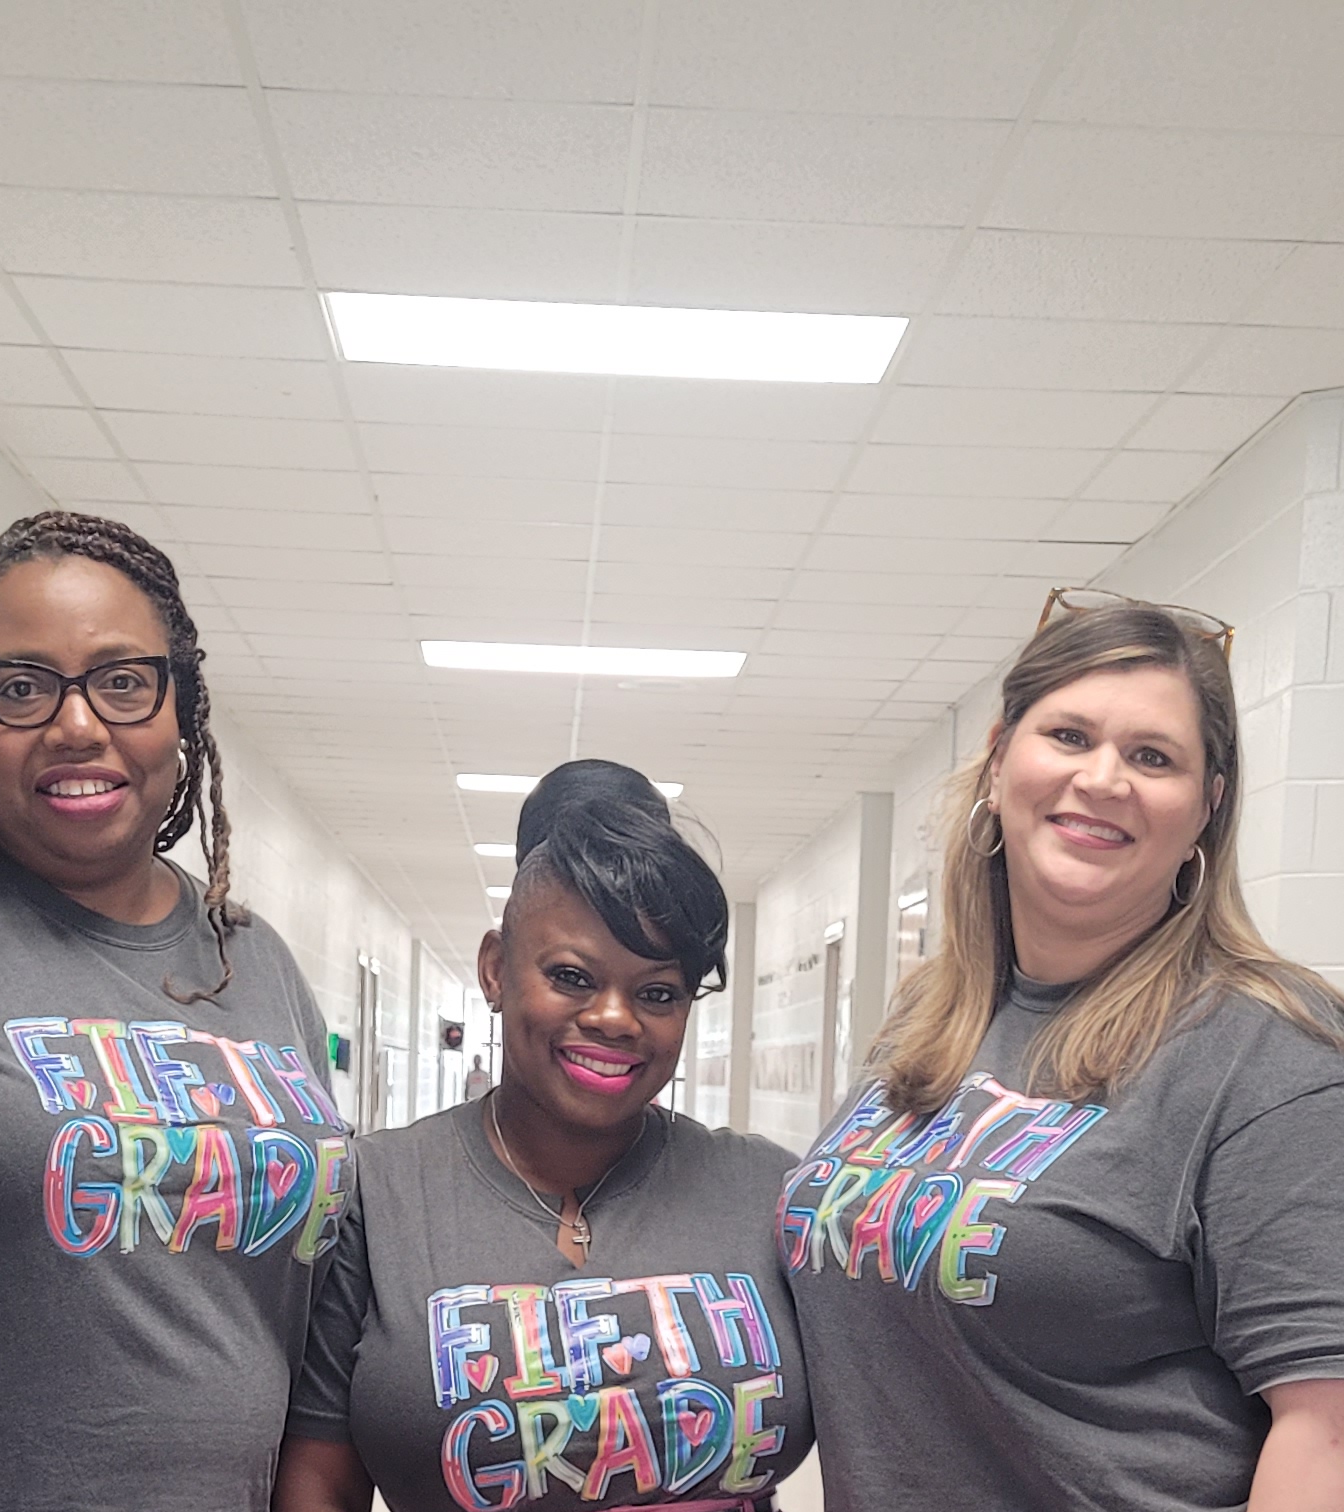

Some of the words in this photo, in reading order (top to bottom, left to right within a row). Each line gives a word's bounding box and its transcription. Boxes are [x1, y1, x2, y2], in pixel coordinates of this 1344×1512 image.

[4, 1016, 346, 1132] FIFTH
[43, 1115, 353, 1263] GRADE
[776, 1157, 1027, 1306] GRADE
[428, 1272, 780, 1408] FIFTH
